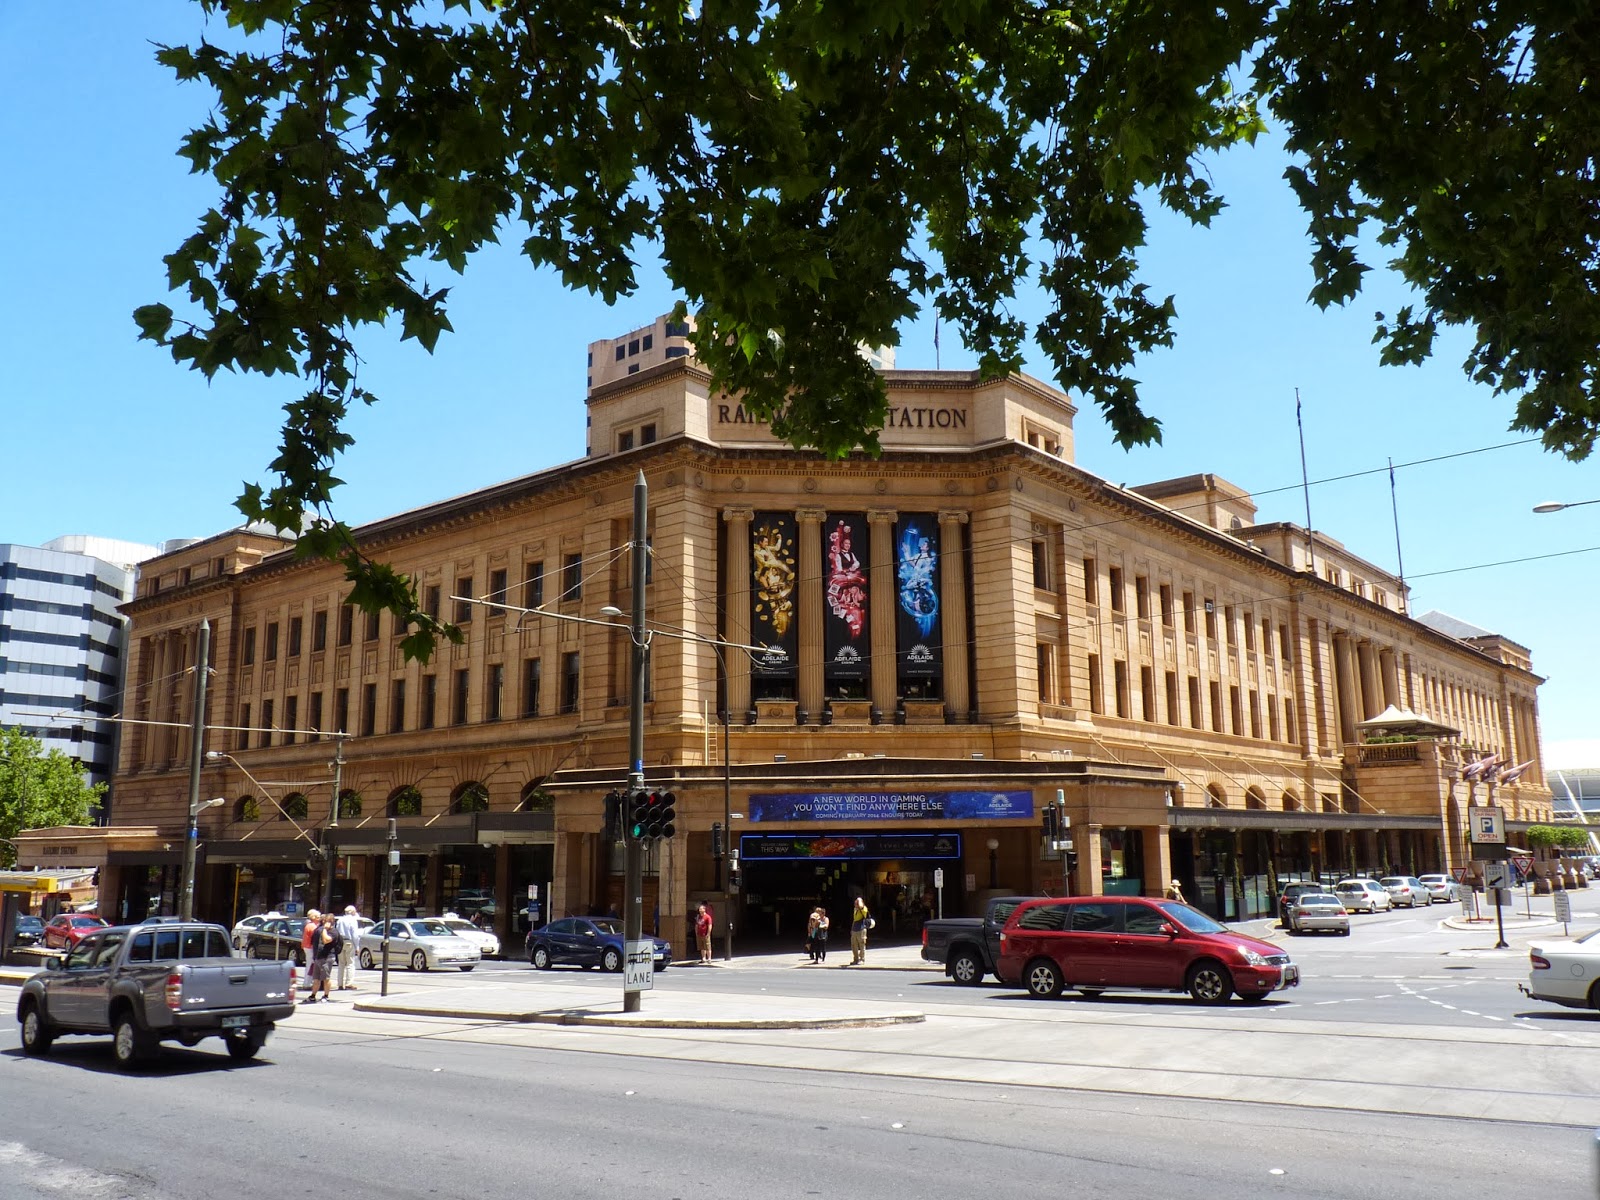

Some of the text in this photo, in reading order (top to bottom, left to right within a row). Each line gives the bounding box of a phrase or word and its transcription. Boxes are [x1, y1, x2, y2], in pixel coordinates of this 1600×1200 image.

[886, 406, 967, 428] TATION
[844, 795, 877, 803] WORLD
[794, 803, 812, 811] YOU
[815, 803, 843, 811] WON'T
[846, 803, 867, 811] FIND
[868, 802, 919, 810] ANYWHERE
[1482, 818, 1492, 832] P
[627, 971, 651, 985] LANE
